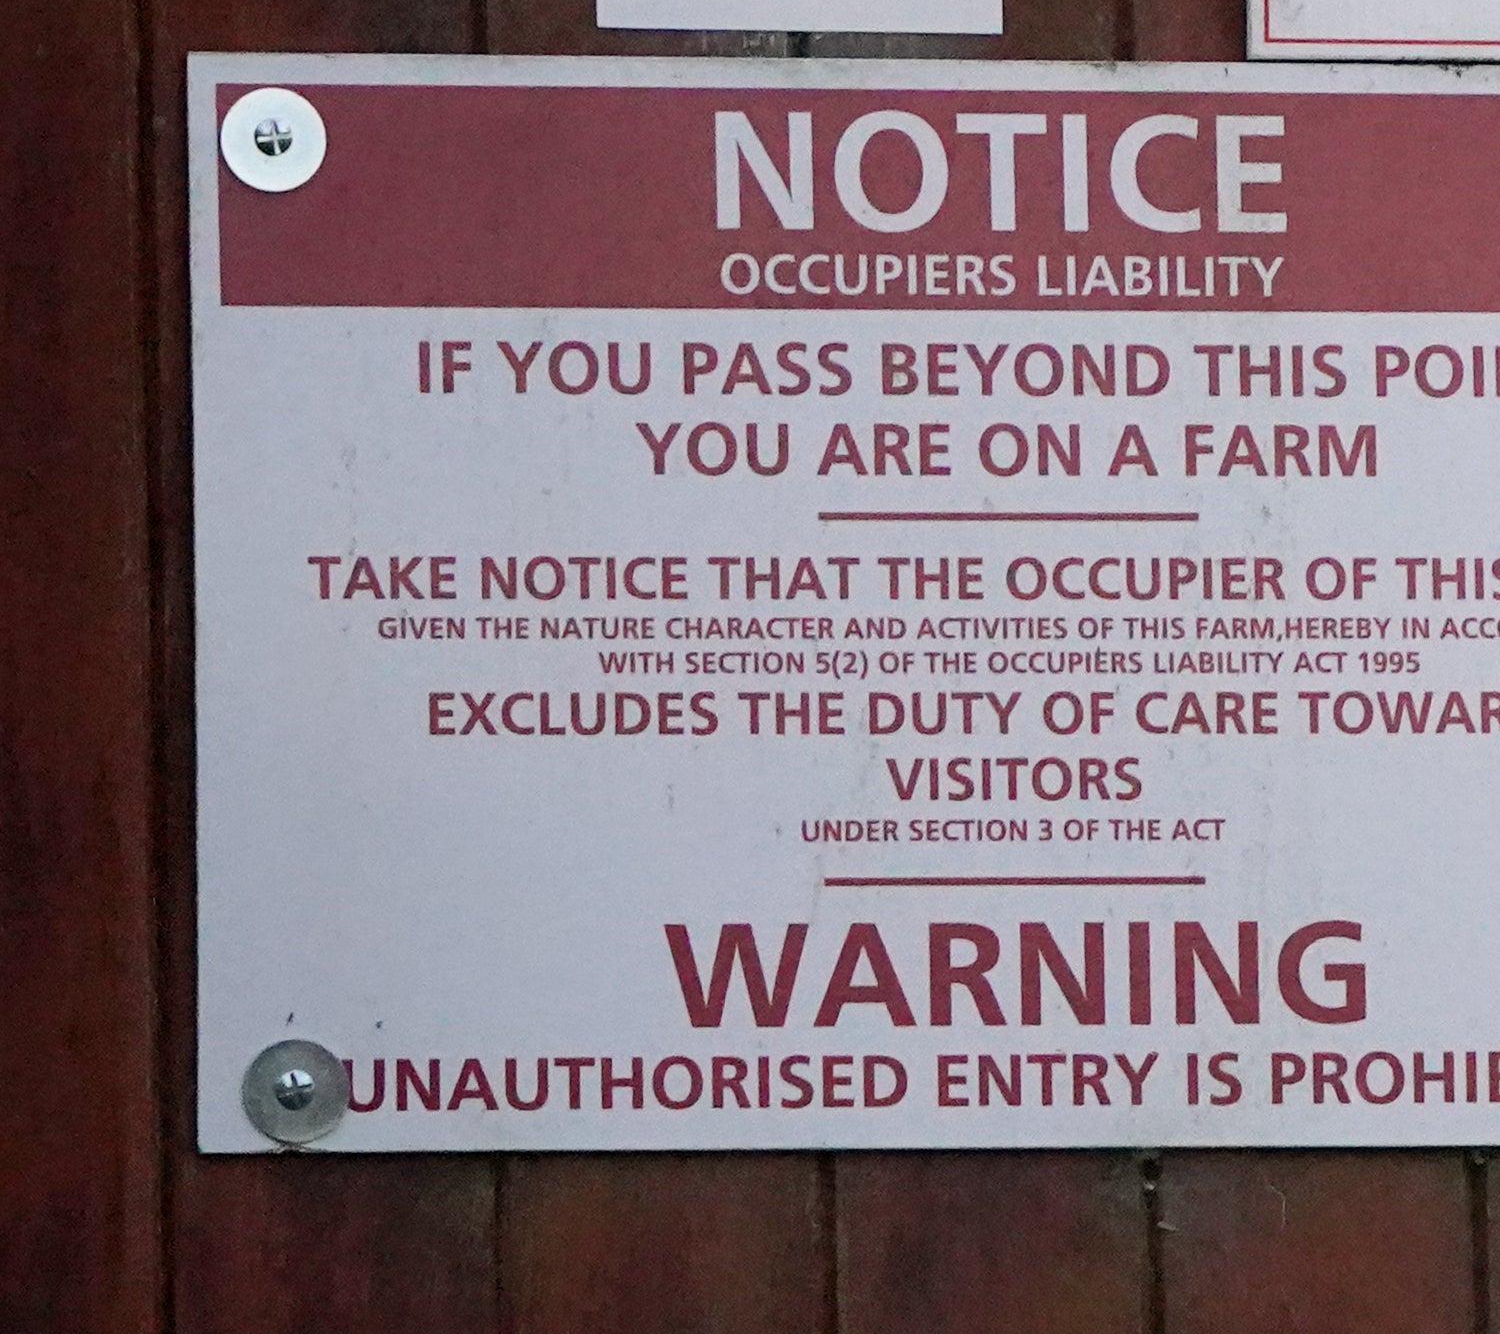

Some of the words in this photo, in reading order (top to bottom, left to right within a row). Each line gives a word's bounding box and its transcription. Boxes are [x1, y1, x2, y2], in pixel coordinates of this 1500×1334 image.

[715, 110, 1287, 232] NOTICE
[721, 253, 1015, 296] OCCUPIERS
[1038, 256, 1284, 296] LIABILITY
[419, 341, 471, 394] IF
[497, 341, 651, 395] YOU
[683, 342, 852, 396] PASS
[882, 343, 1170, 397] BEYOND
[1194, 345, 1346, 398] THIS
[636, 422, 788, 476] YOU
[817, 424, 951, 476] ARE
[979, 423, 1080, 477] ON
[1108, 425, 1158, 476] A
[1185, 425, 1376, 477] FARM
[308, 556, 456, 599] TAKE
[481, 556, 688, 600] NOTICE
[708, 557, 860, 600] THAT
[878, 557, 984, 600] THE
[1006, 557, 1285, 601] OCCUPIER
[1306, 557, 1376, 600] OF
[378, 617, 465, 639] GIVEN
[476, 617, 529, 639] THE
[541, 617, 655, 639] NATURE
[666, 617, 834, 640] CHARACTER
[844, 618, 906, 639] AND
[917, 617, 1067, 639] ACTIVITIES
[1078, 617, 1113, 639] OF
[1123, 617, 1185, 639] THIS
[1402, 617, 1430, 639] IN
[599, 652, 674, 674] WITH
[685, 652, 804, 674] SECTION
[816, 650, 868, 680] 5(2)
[879, 652, 914, 674] OF
[924, 652, 976, 674] THE
[988, 652, 1142, 674] OCCUPIERS
[1154, 652, 1283, 673] LIABILITY
[1294, 652, 1348, 673] ACT
[1359, 652, 1420, 673] 1995
[429, 692, 718, 735] EXCLUDES
[738, 692, 845, 734] THE
[869, 692, 1021, 735] DUTY
[1043, 691, 1114, 735] OF
[1136, 692, 1278, 734] CARE
[886, 757, 1142, 801] VISITORS
[802, 820, 898, 842] UNDER
[909, 819, 1027, 841] SECTION
[1039, 819, 1052, 841] 3
[1064, 819, 1099, 841] OF
[1108, 819, 1161, 841] THE
[1172, 819, 1225, 840] ACT
[664, 920, 1366, 1028] WARNING
[343, 1054, 907, 1113] UNAUTHORISED
[938, 1052, 1158, 1107] ENTRY
[1187, 1052, 1242, 1106] IS
